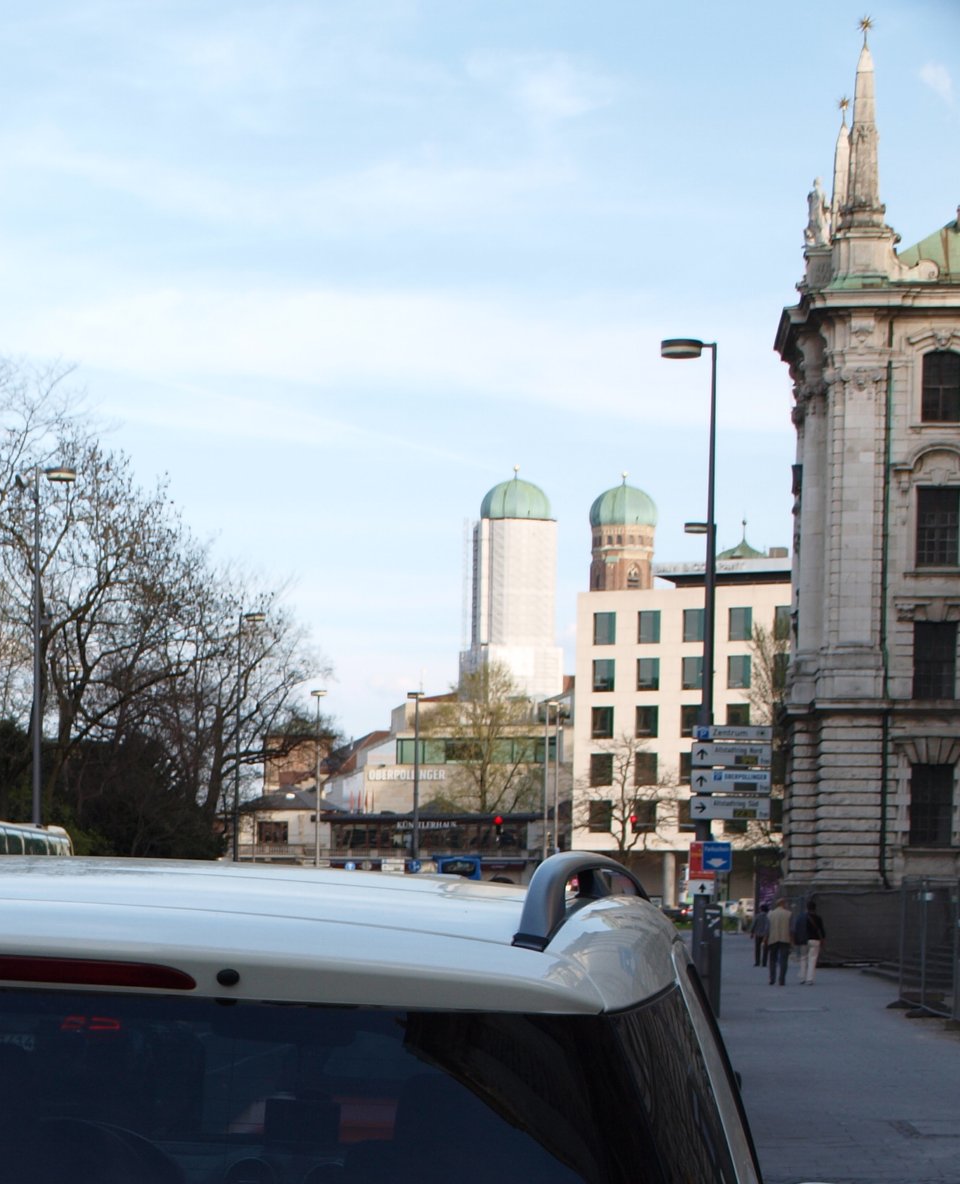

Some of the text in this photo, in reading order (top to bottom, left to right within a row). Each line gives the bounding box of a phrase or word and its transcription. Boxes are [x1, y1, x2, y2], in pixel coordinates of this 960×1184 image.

[712, 728, 749, 738] Zentrum
[368, 769, 445, 780] OBERPOLLNGER
[397, 820, 457, 829] KÜNTLERHAUS
